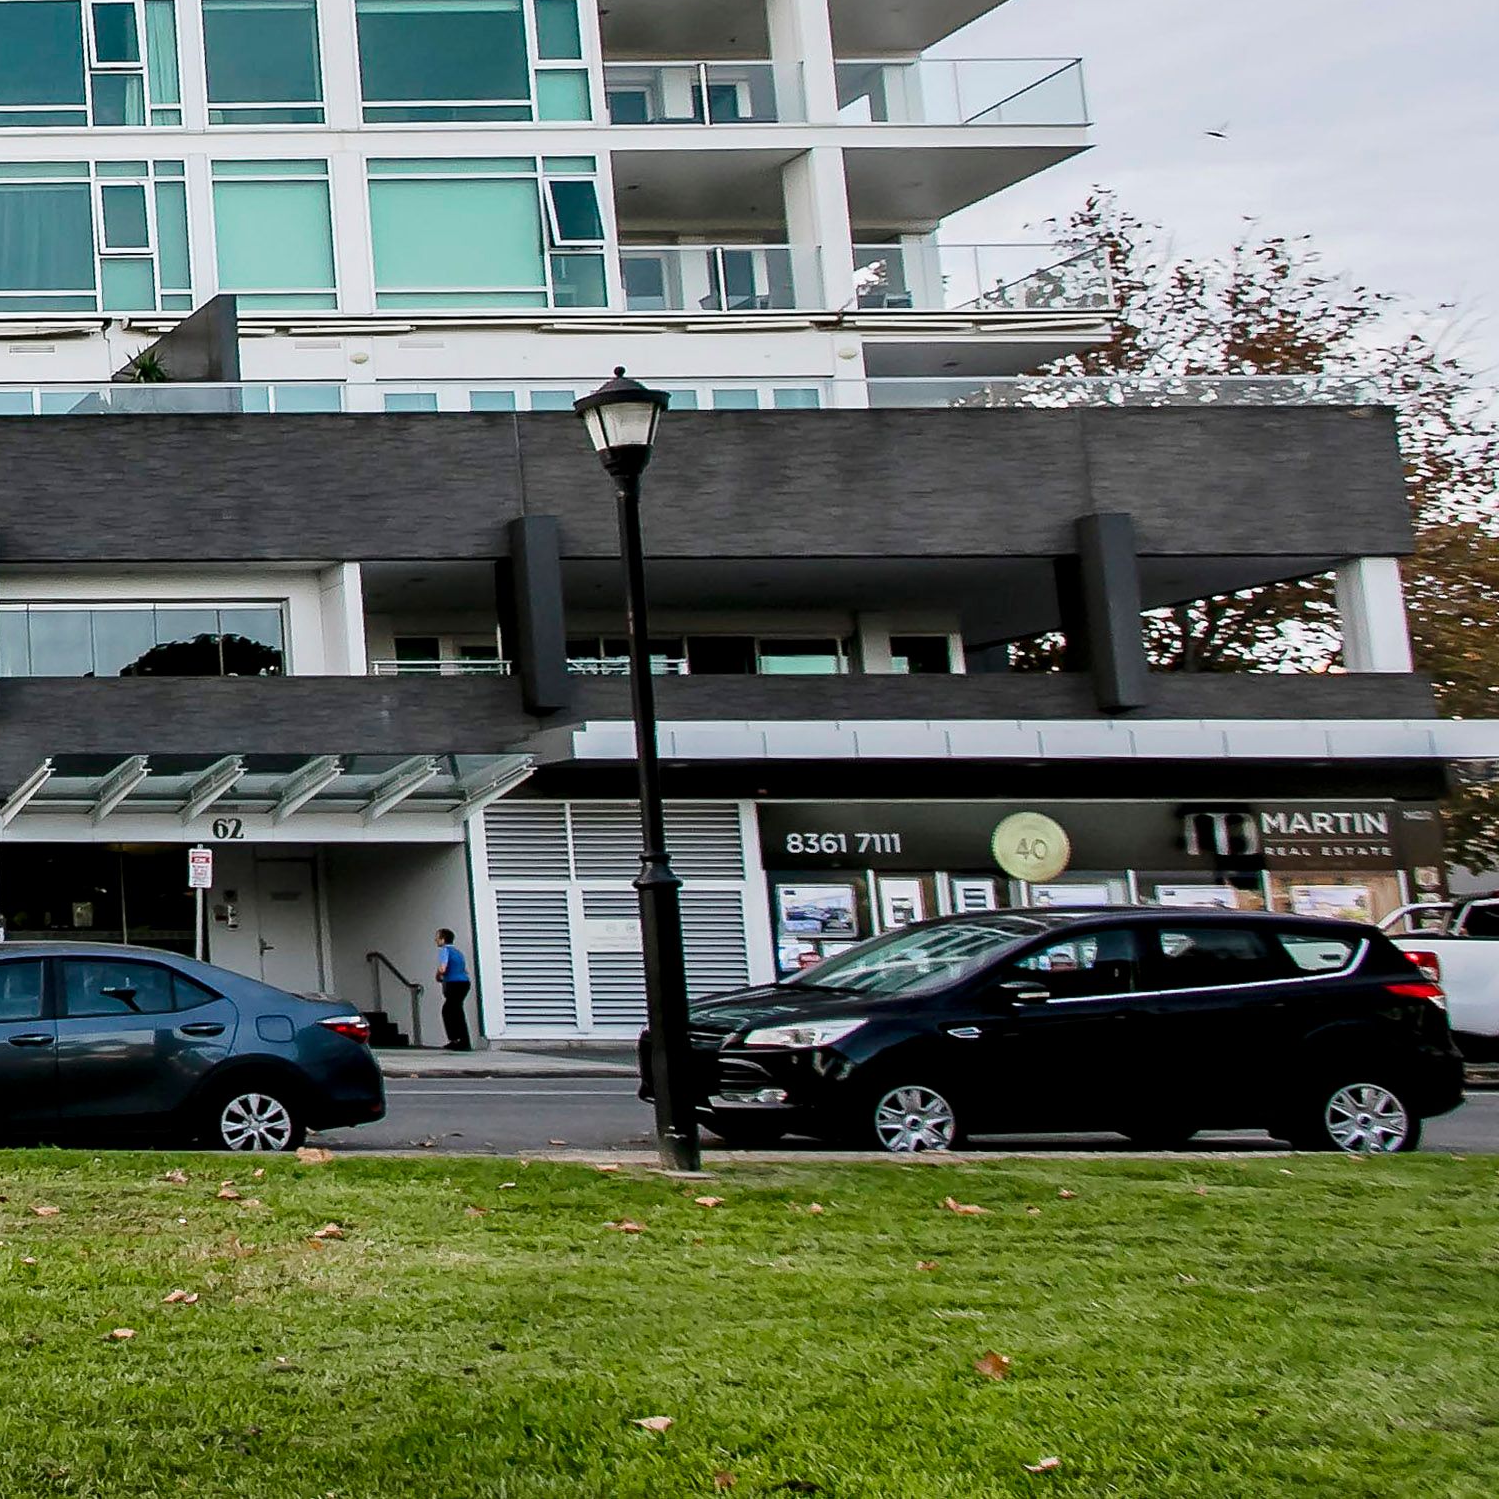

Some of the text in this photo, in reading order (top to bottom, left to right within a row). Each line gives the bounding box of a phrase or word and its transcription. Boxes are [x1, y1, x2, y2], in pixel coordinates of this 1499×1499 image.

[212, 818, 244, 839] 62
[1260, 812, 1389, 835] MARTIN
[786, 832, 901, 854] 8361 7111
[1015, 838, 1048, 860] 40
[1264, 846, 1393, 856] REAL ESTATE
